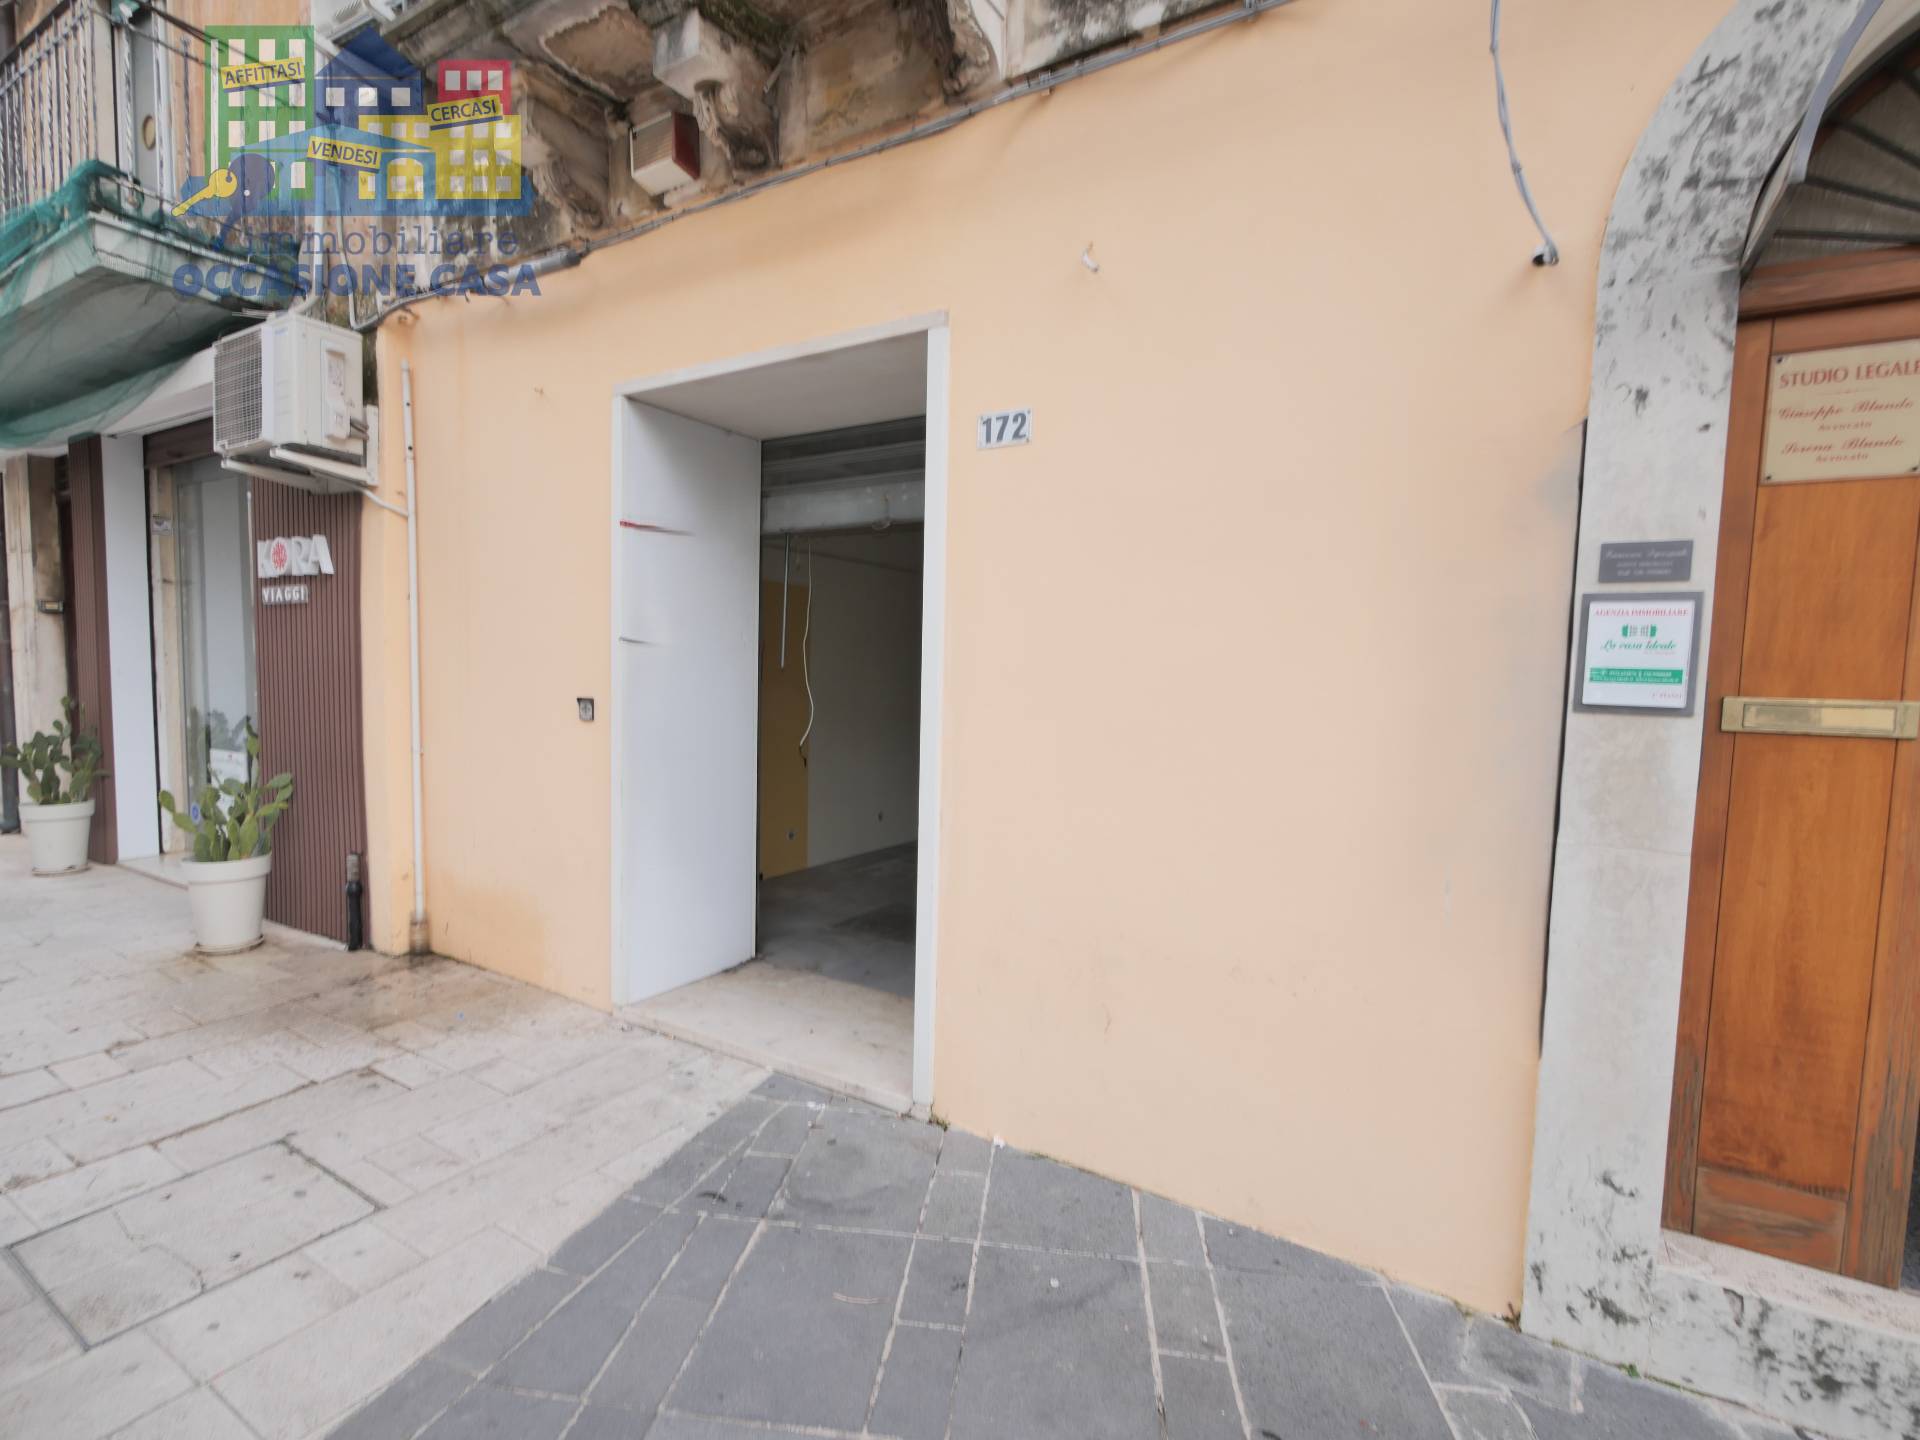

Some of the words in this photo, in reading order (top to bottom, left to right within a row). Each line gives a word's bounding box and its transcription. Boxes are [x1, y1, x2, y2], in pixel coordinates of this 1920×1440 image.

[1778, 366, 1850, 389] STUDIO
[982, 412, 1027, 444] 172
[262, 586, 305, 603] VIAGGI
